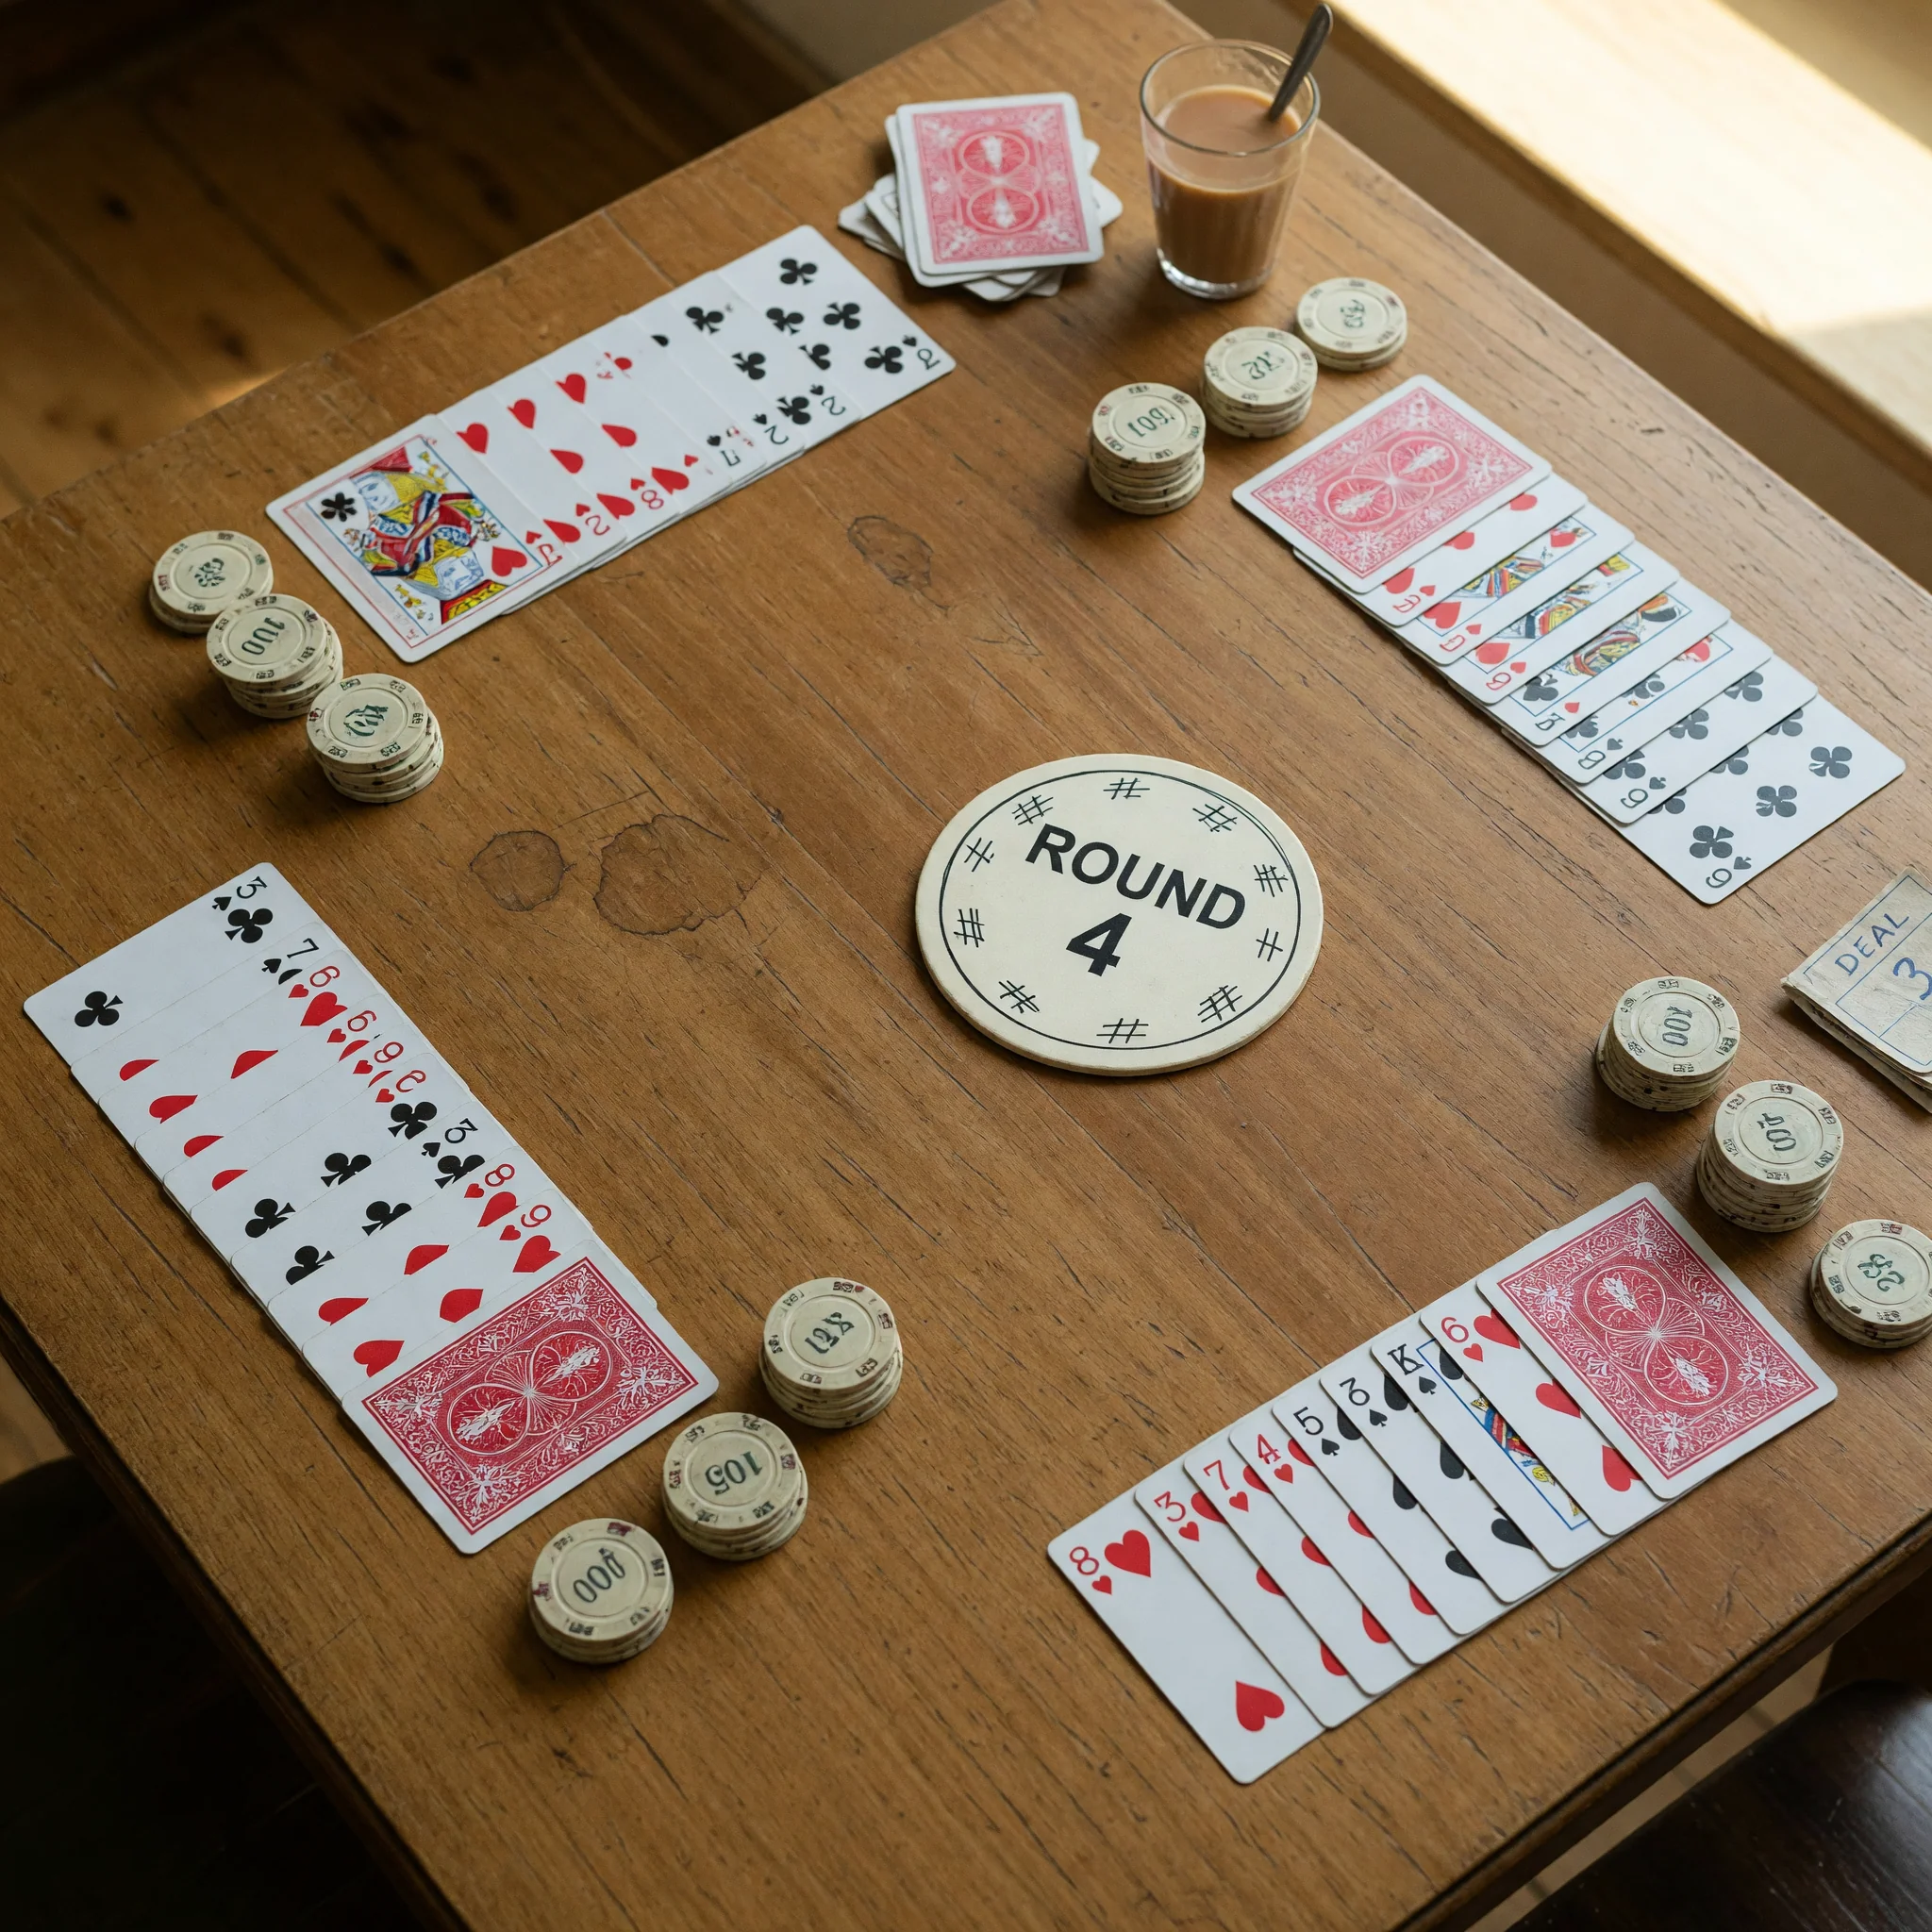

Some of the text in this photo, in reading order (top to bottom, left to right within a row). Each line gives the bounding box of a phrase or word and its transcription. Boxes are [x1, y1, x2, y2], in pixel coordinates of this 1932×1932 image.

[821, 396, 846, 416] 2
[764, 425, 790, 445] 2
[641, 490, 665, 509] 8
[236, 875, 268, 899] 3
[1024, 823, 1246, 930] ROUND
[286, 938, 320, 958] 7
[1065, 912, 1133, 977] 4
[1834, 912, 1910, 977] DEAL
[309, 966, 341, 988] 6
[1892, 957, 1932, 1001] 3
[347, 1010, 377, 1032] 6
[484, 1163, 516, 1187] 8
[521, 1205, 552, 1228] 9
[1441, 1316, 1470, 1343] 6
[1387, 1343, 1425, 1375] K
[1293, 1407, 1324, 1436] 5
[1257, 1433, 1282, 1465] 4
[705, 1451, 763, 1496] 105
[1203, 1459, 1231, 1491] 7
[1153, 1491, 1187, 1523] 3
[1069, 1546, 1100, 1576] 8
